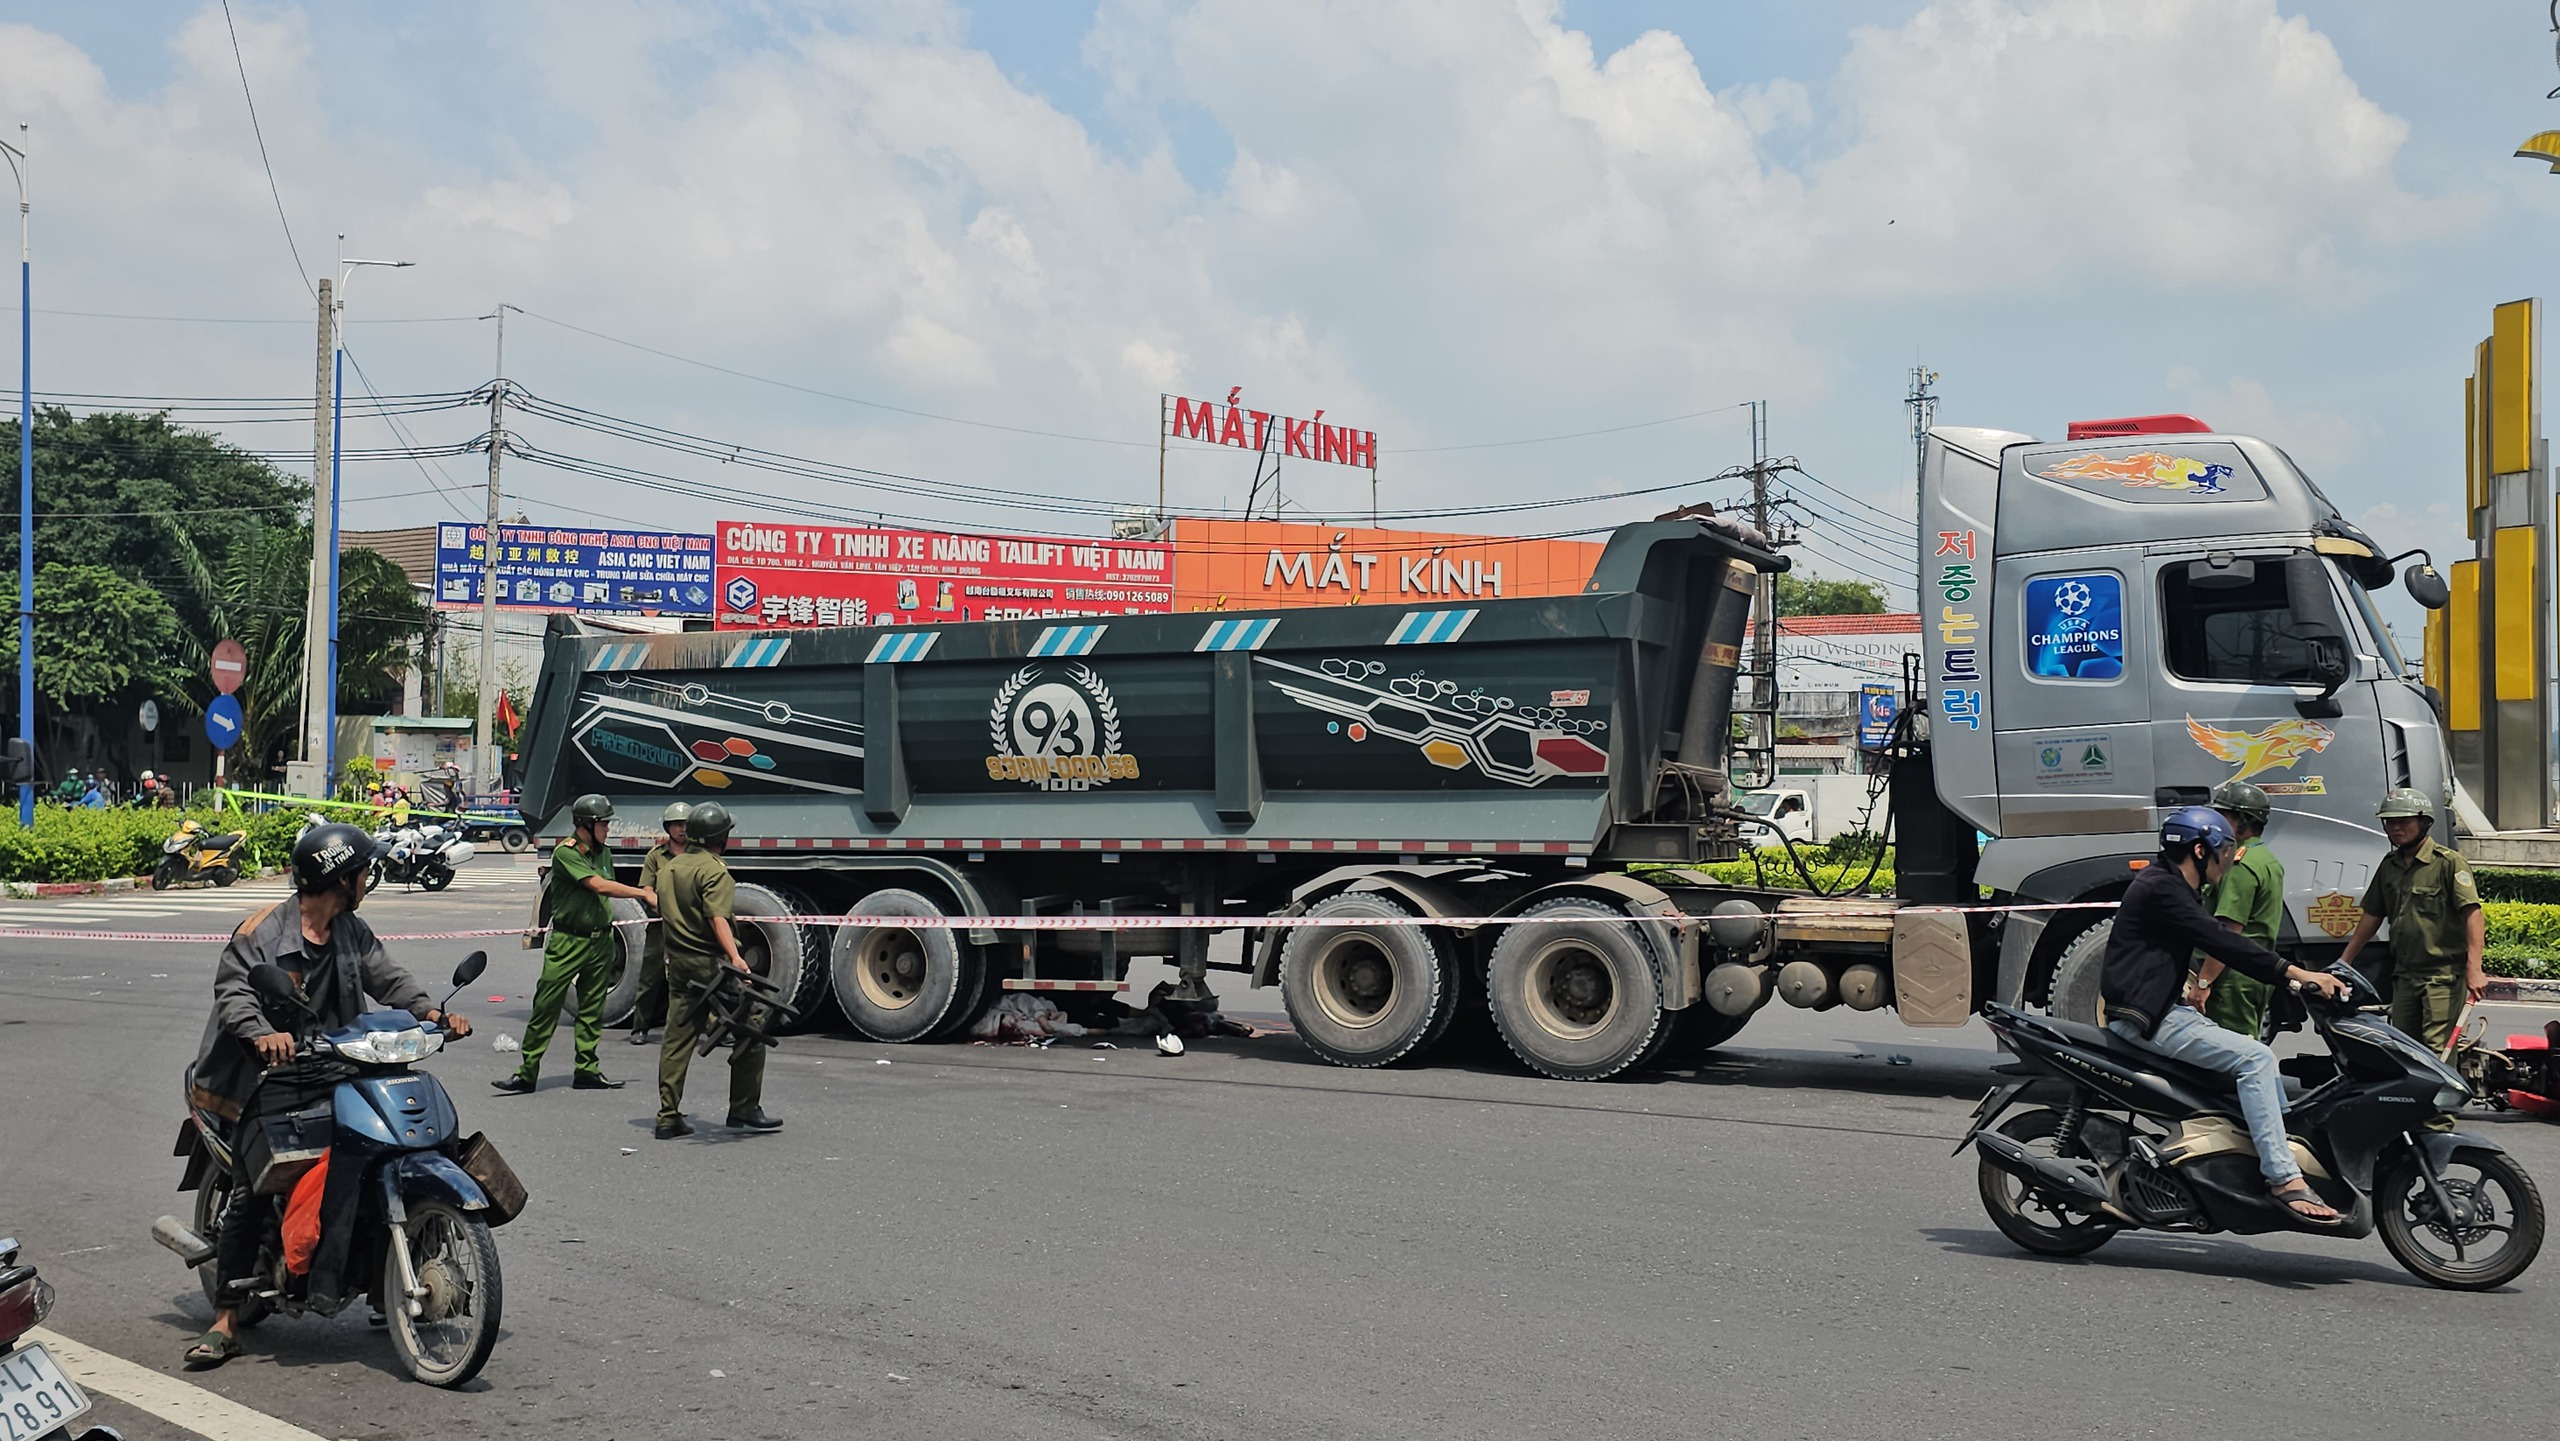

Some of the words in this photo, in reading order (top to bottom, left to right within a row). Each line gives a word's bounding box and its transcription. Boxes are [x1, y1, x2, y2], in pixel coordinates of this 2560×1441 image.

[1173, 386, 1269, 452] MẮT
[1285, 410, 1374, 469] KÍNH
[502, 530, 515, 542] TY
[517, 530, 545, 544] TNHH
[547, 529, 578, 545] CÔNG
[580, 531, 608, 549] NGHỆ
[610, 535, 635, 548] ASIA
[637, 536, 659, 549] CNC
[661, 535, 684, 552] VIỆT
[685, 538, 710, 551] NAM
[726, 523, 786, 553] CÔNG
[795, 531, 823, 555] TY
[832, 533, 889, 558] TNHH
[897, 536, 924, 560] XE
[932, 535, 990, 563] NÂNG
[998, 541, 1065, 566] TAILIFT
[1072, 542, 1113, 571] VIỆT
[1117, 549, 1165, 571] NAM
[599, 552, 626, 567] ASIA
[629, 553, 653, 568] CNC
[656, 554, 680, 569] VIET
[683, 555, 710, 570] NAM
[1263, 532, 1378, 591] MẮT
[1400, 547, 1502, 597] KÍNH
[762, 595, 868, 626] 宇锋智能
[2031, 629, 2119, 646] CHAMPIONS
[2060, 619, 2087, 630] UEFA
[1826, 643, 1915, 656] WEDDING
[2053, 643, 2098, 655] LEAGUE
[0, 1354, 44, 1393] -L1
[0, 1381, 79, 1441] 28.91
